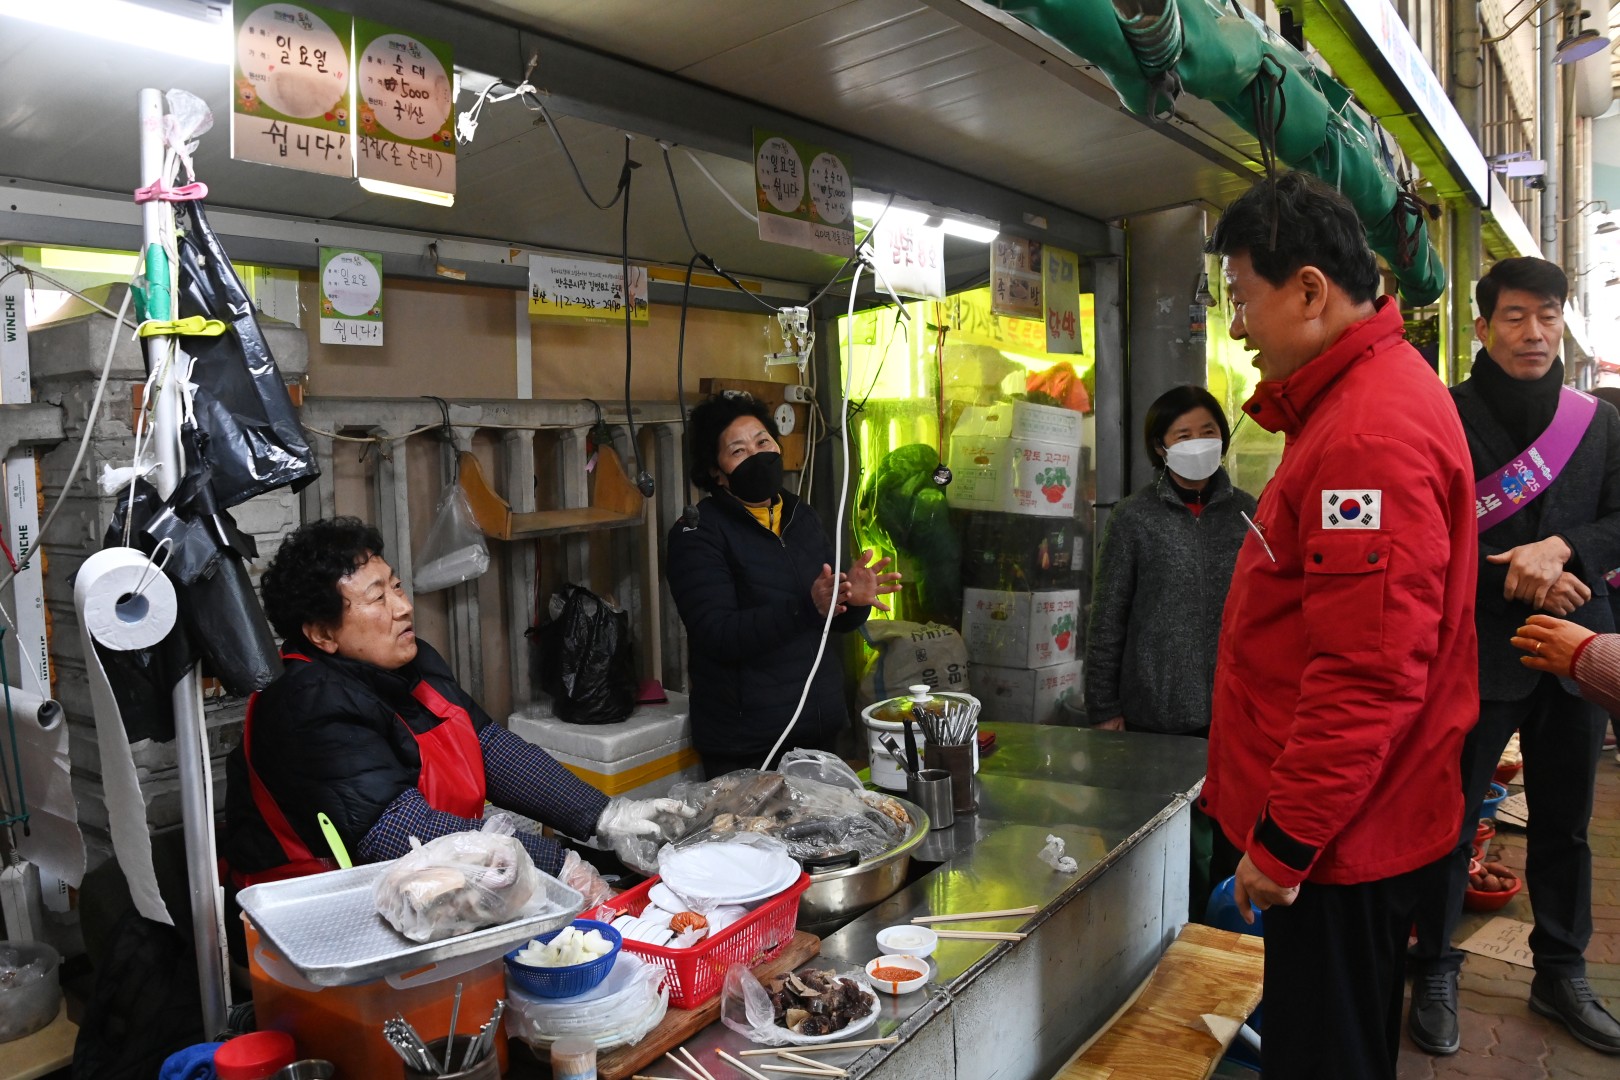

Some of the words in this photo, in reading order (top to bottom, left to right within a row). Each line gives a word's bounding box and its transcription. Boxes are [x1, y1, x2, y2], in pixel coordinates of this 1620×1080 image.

[276, 35, 329, 74] 일요일
[393, 53, 426, 80] 순대
[393, 99, 426, 125] 국내산
[262, 120, 346, 161] 쉽니다!
[770, 154, 797, 178] 일요일
[773, 178, 800, 201] 쉽니다
[340, 268, 368, 287] 일요일
[533, 287, 547, 304] 부산
[5, 295, 17, 342] WINCHE
[334, 321, 377, 342] 쉽니다!
[1048, 307, 1076, 340] 닭발
[1023, 448, 1041, 462] 황토
[1044, 452, 1071, 466] 고구마
[18, 525, 31, 571] WNCHE
